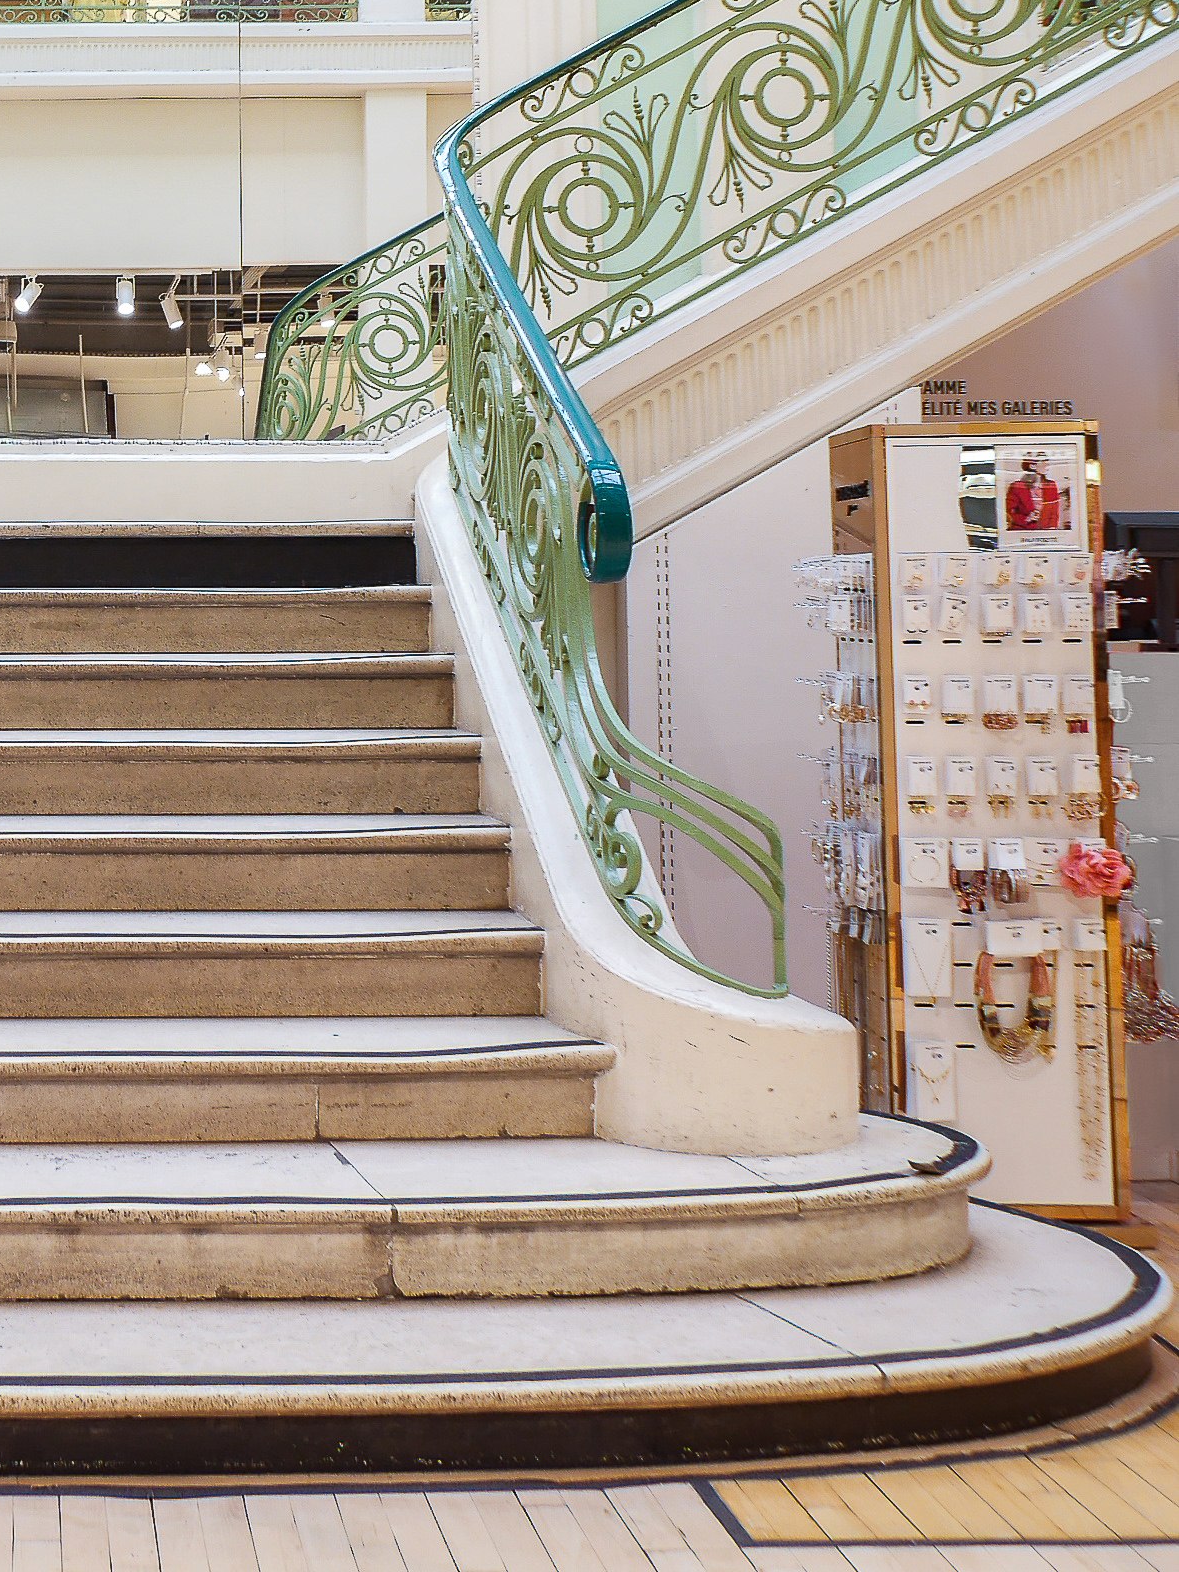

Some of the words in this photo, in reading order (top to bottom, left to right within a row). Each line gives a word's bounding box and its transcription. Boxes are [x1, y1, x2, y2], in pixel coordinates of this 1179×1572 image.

[922, 380, 967, 395] AMME
[922, 399, 963, 416] ÉLITÉ
[967, 400, 997, 416] MES
[1002, 400, 1073, 416] GALERIES
